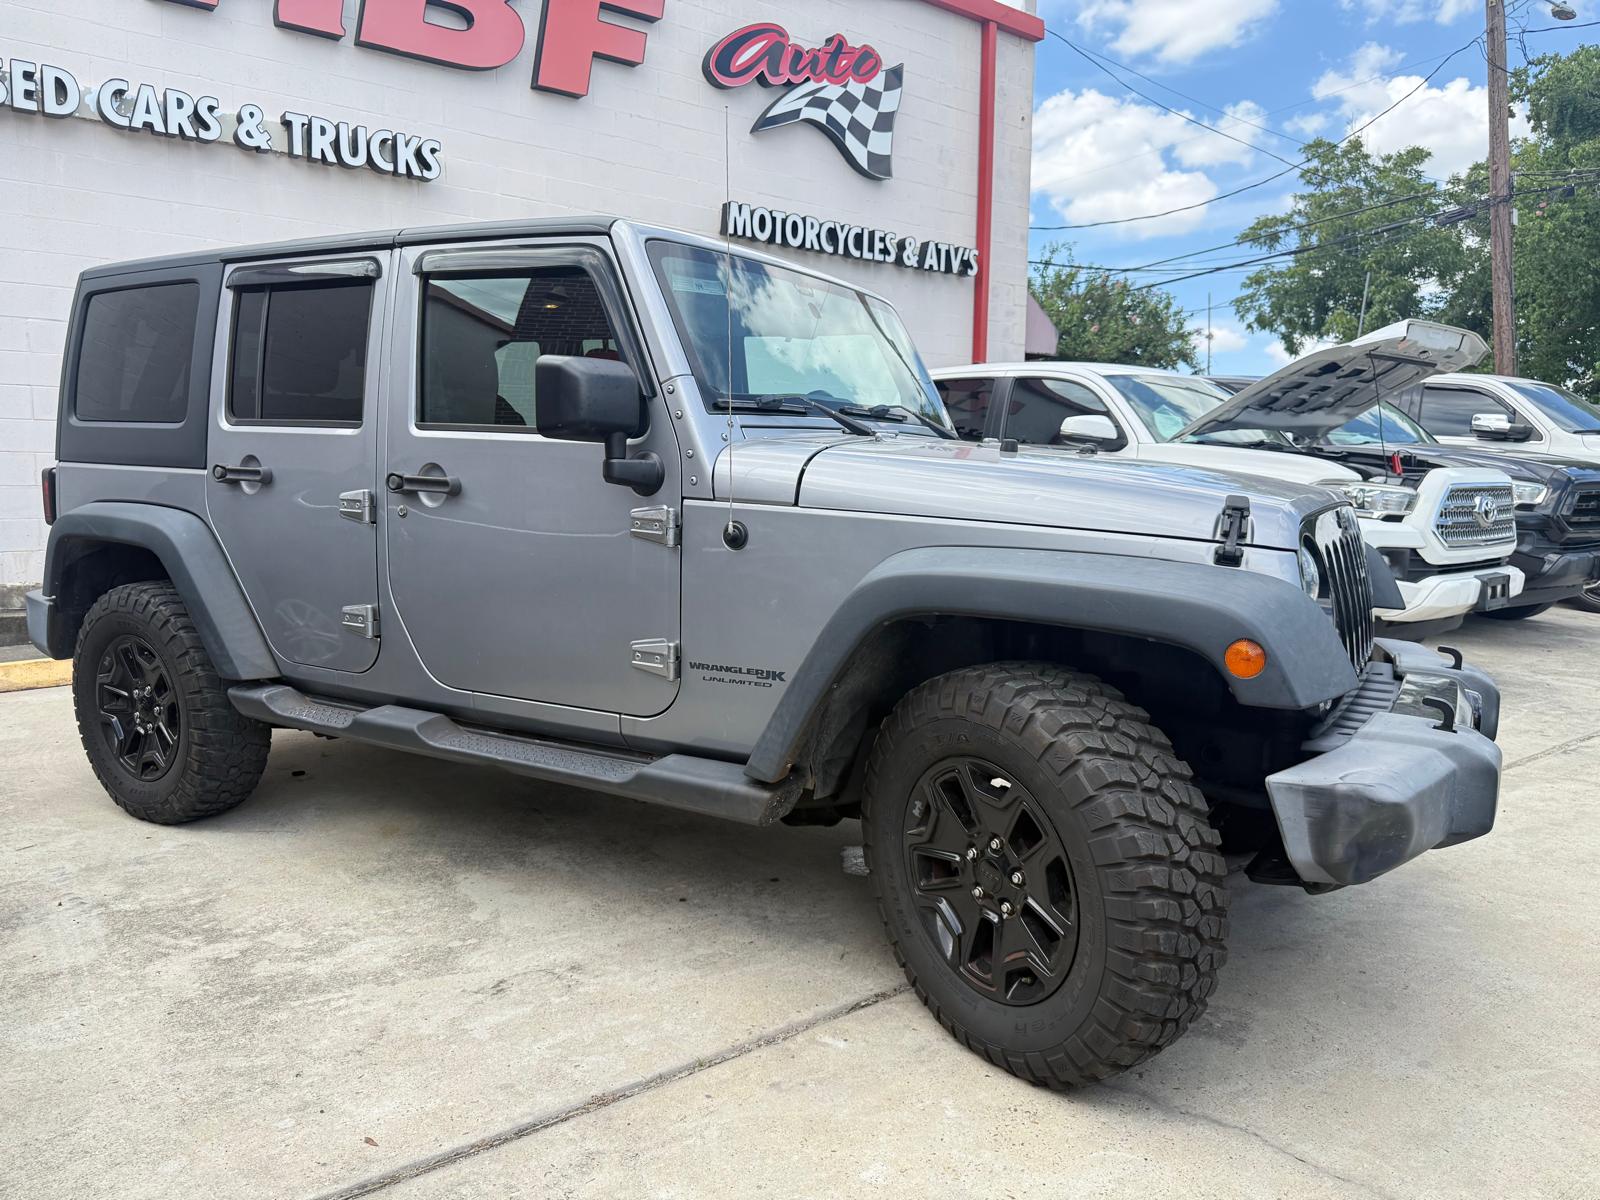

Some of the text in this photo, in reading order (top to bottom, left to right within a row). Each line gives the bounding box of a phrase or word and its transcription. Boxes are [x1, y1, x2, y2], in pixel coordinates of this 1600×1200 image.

[0, 57, 441, 182] ED CARS & TRUCKS
[721, 200, 979, 278] MOTORCYCLES & ATV'S
[702, 675, 773, 688] UNLIMITED
